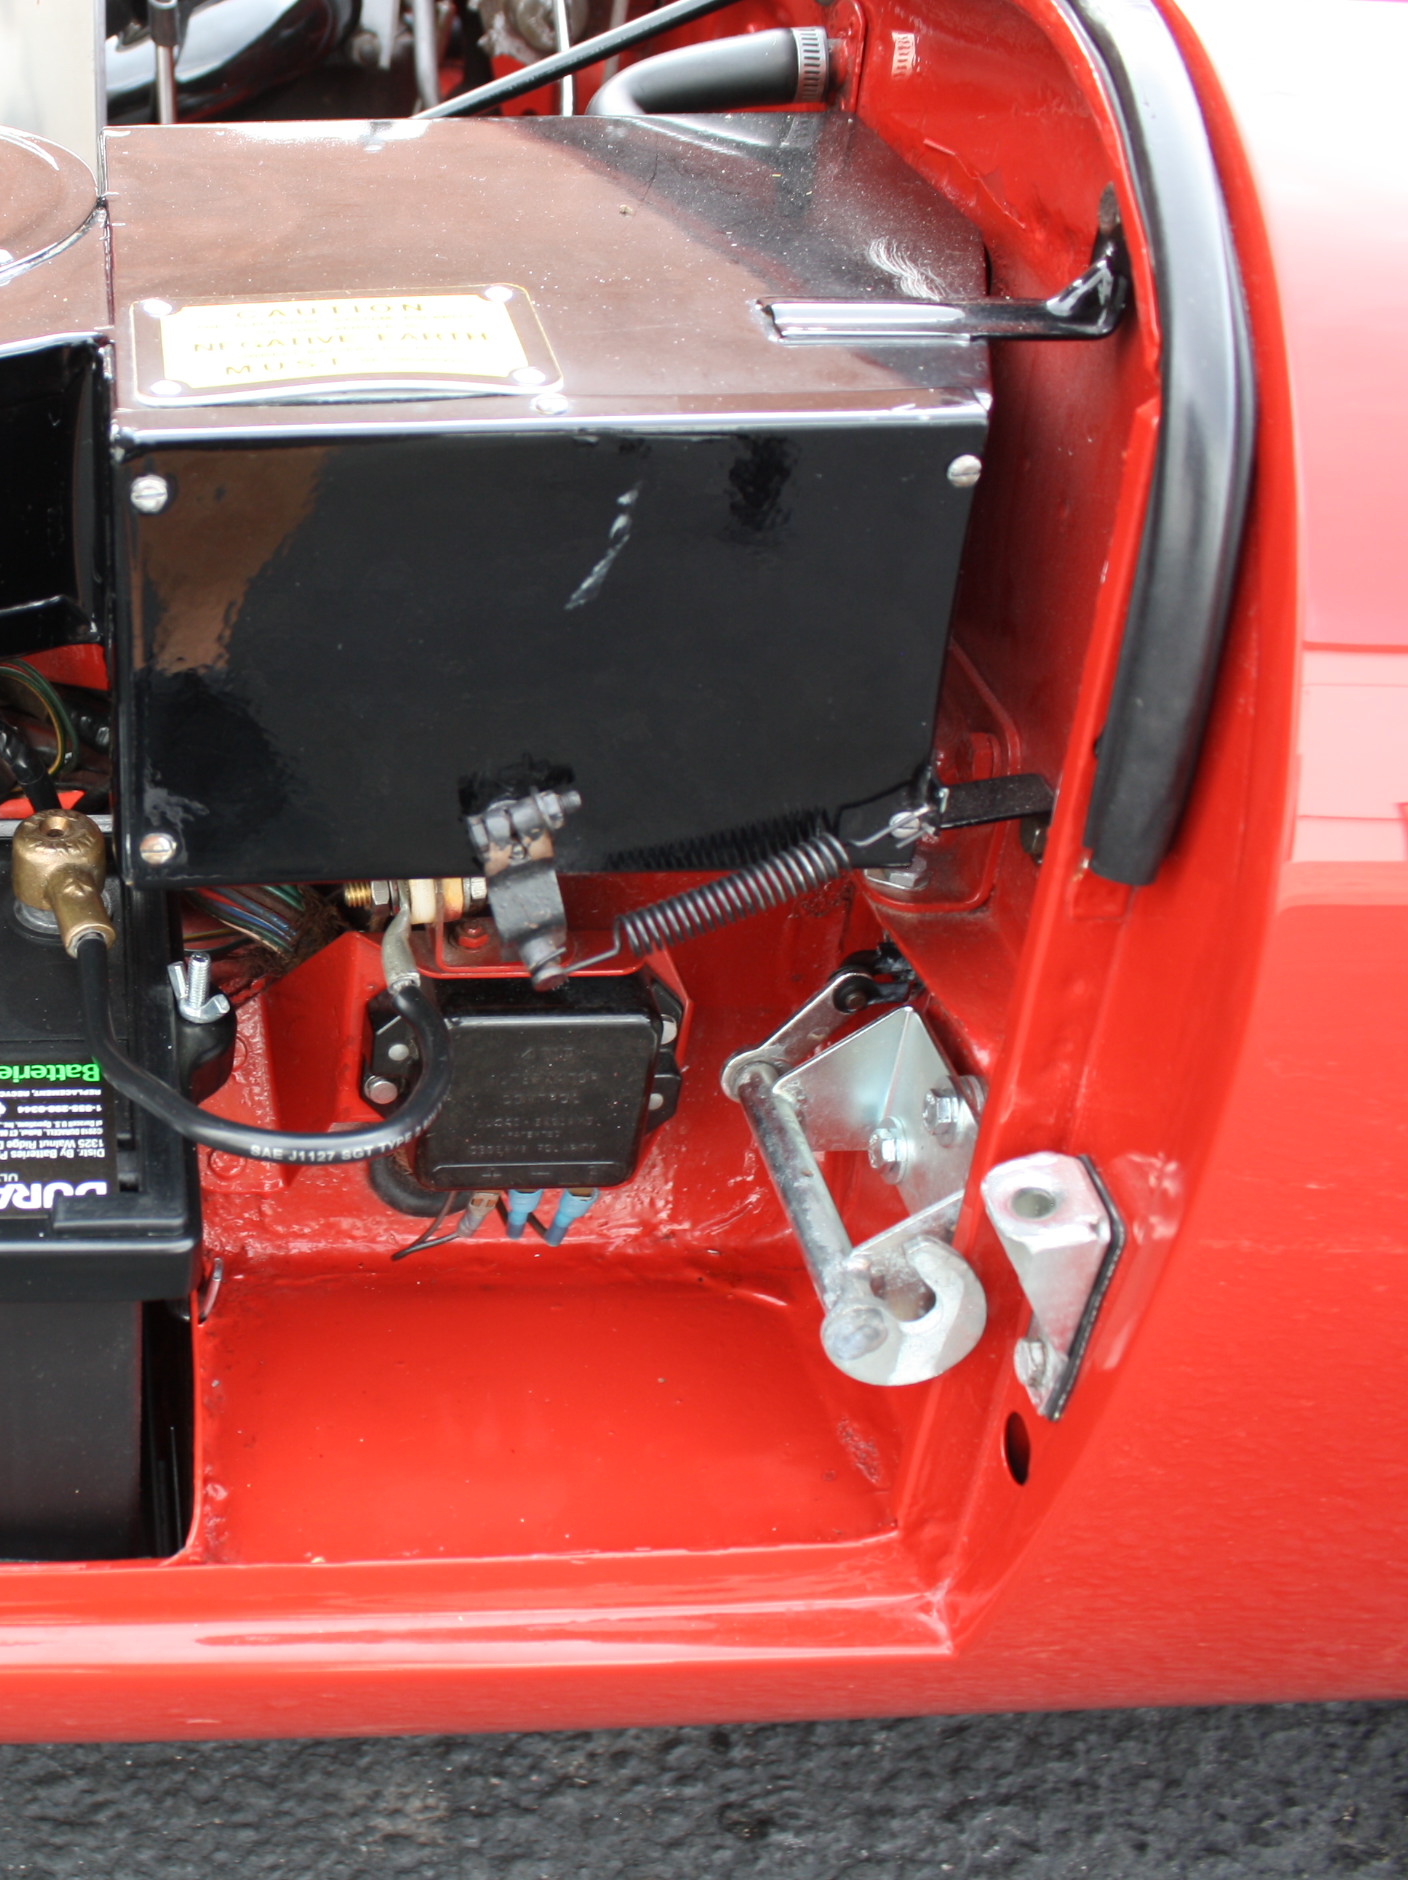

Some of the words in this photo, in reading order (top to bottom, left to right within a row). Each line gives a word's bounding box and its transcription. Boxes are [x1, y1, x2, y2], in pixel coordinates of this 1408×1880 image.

[235, 303, 424, 318] CAUTION
[193, 335, 352, 353] NEGATIVE
[376, 331, 490, 343] EARTH
[226, 357, 339, 375] MUST
[7, 1137, 37, 1150] Ridge
[39, 1140, 76, 1149] Walnut
[78, 1139, 104, 1148] 1325
[250, 1144, 284, 1161] SAE
[288, 1149, 335, 1162] J1127
[342, 1145, 373, 1161] SGT
[375, 1132, 413, 1153] TYPE
[10, 1149, 58, 1159] Batteries
[60, 1147, 74, 1159] By
